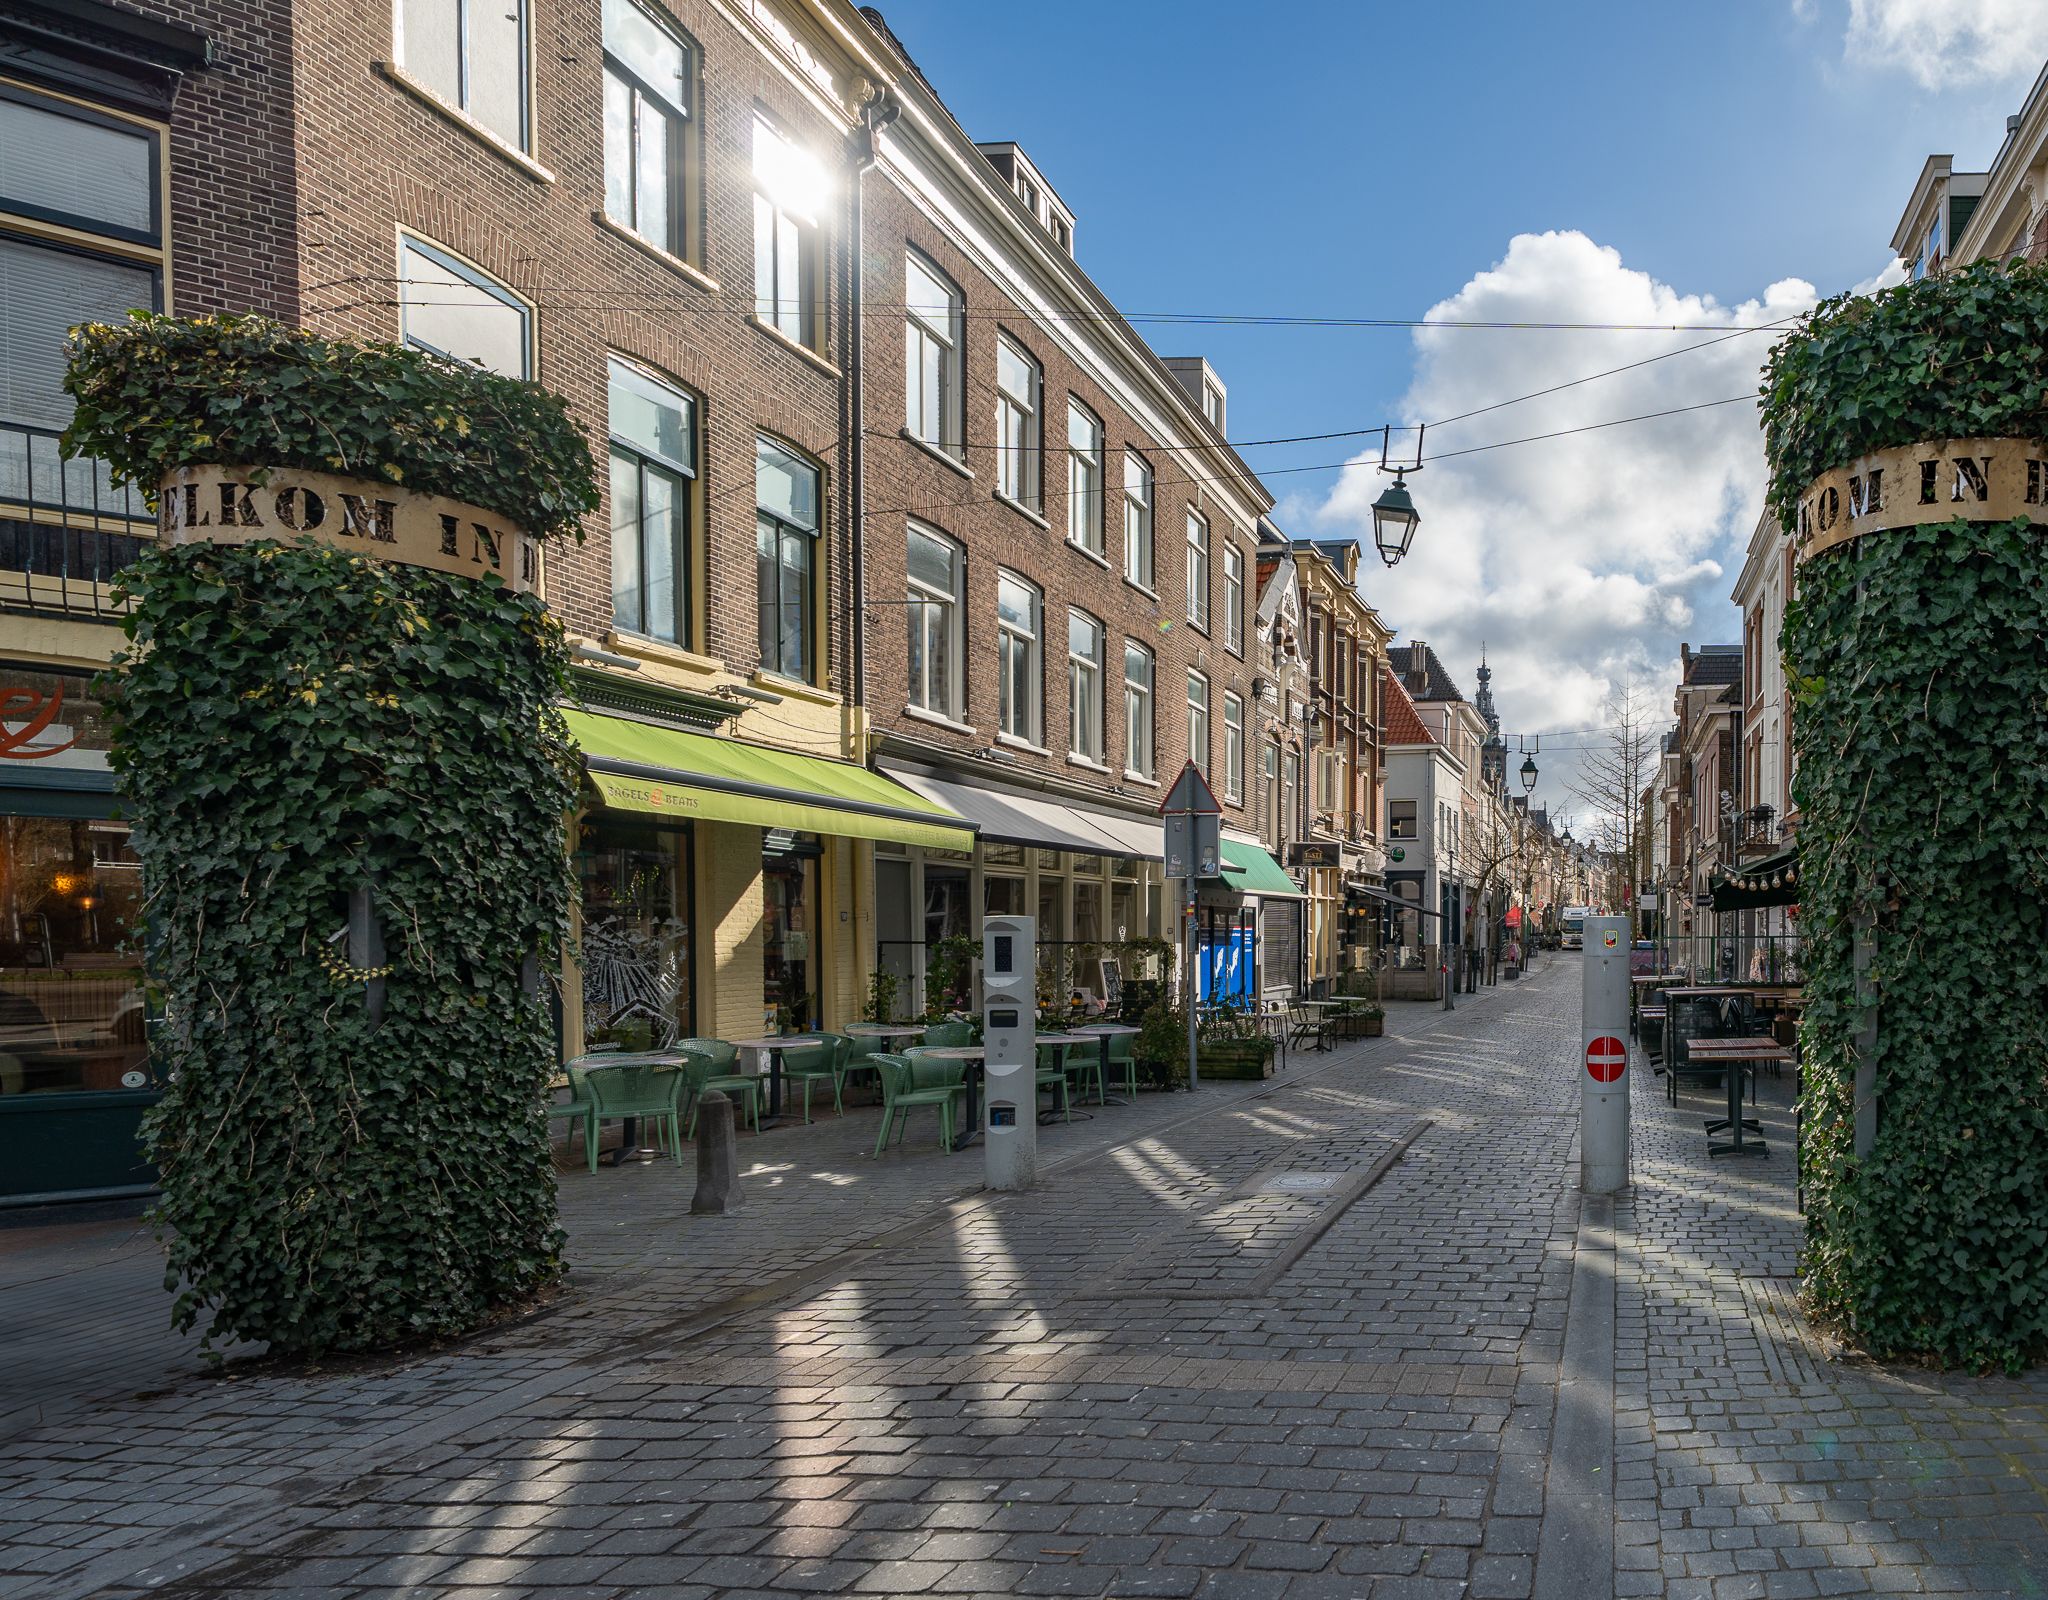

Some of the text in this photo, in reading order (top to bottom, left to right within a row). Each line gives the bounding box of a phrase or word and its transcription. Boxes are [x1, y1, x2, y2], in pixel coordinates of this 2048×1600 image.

[1918, 457, 1993, 505] IN
[438, 512, 504, 569] IN
[607, 786, 650, 802] BAGELS
[665, 794, 699, 809] BEANS
